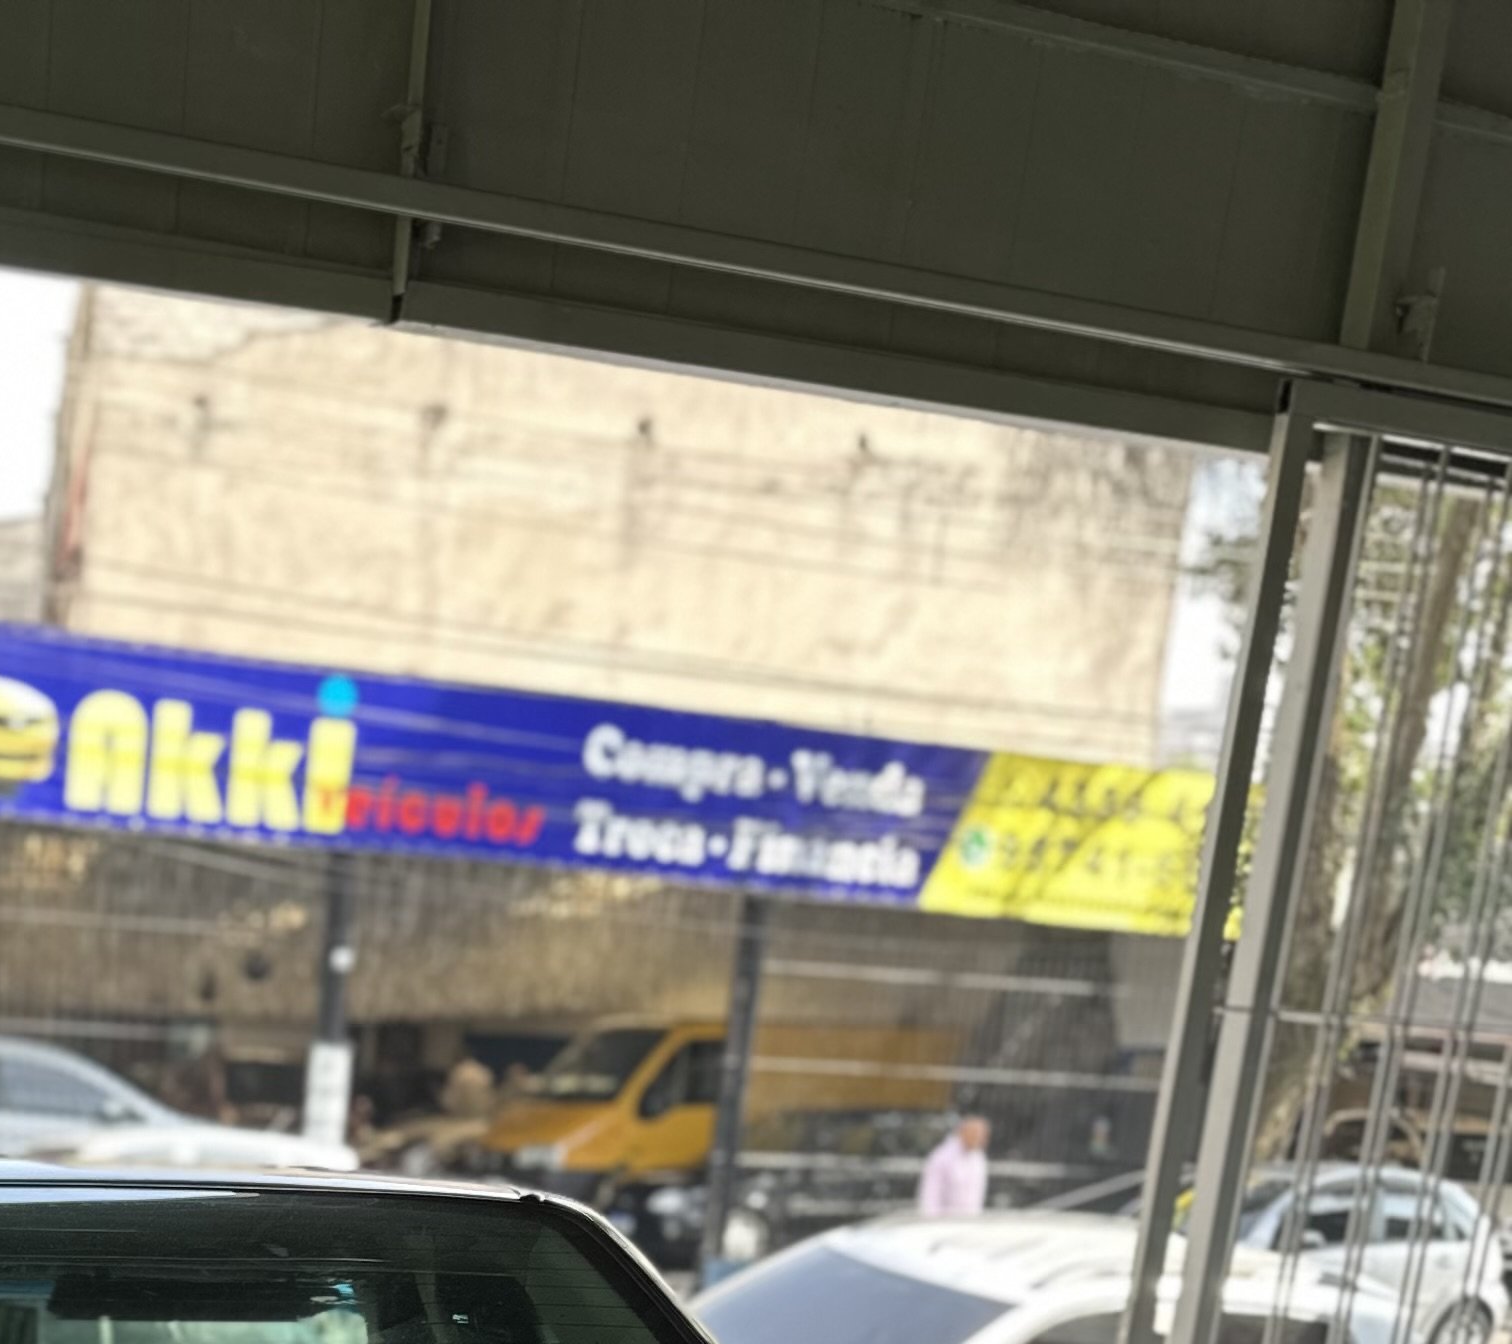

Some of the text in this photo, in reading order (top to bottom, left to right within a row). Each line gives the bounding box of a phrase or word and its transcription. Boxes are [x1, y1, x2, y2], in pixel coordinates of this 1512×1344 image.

[64, 674, 359, 835] Akki
[582, 723, 766, 802] Compra
[791, 748, 925, 817] Venda
[574, 798, 707, 868] Troca
